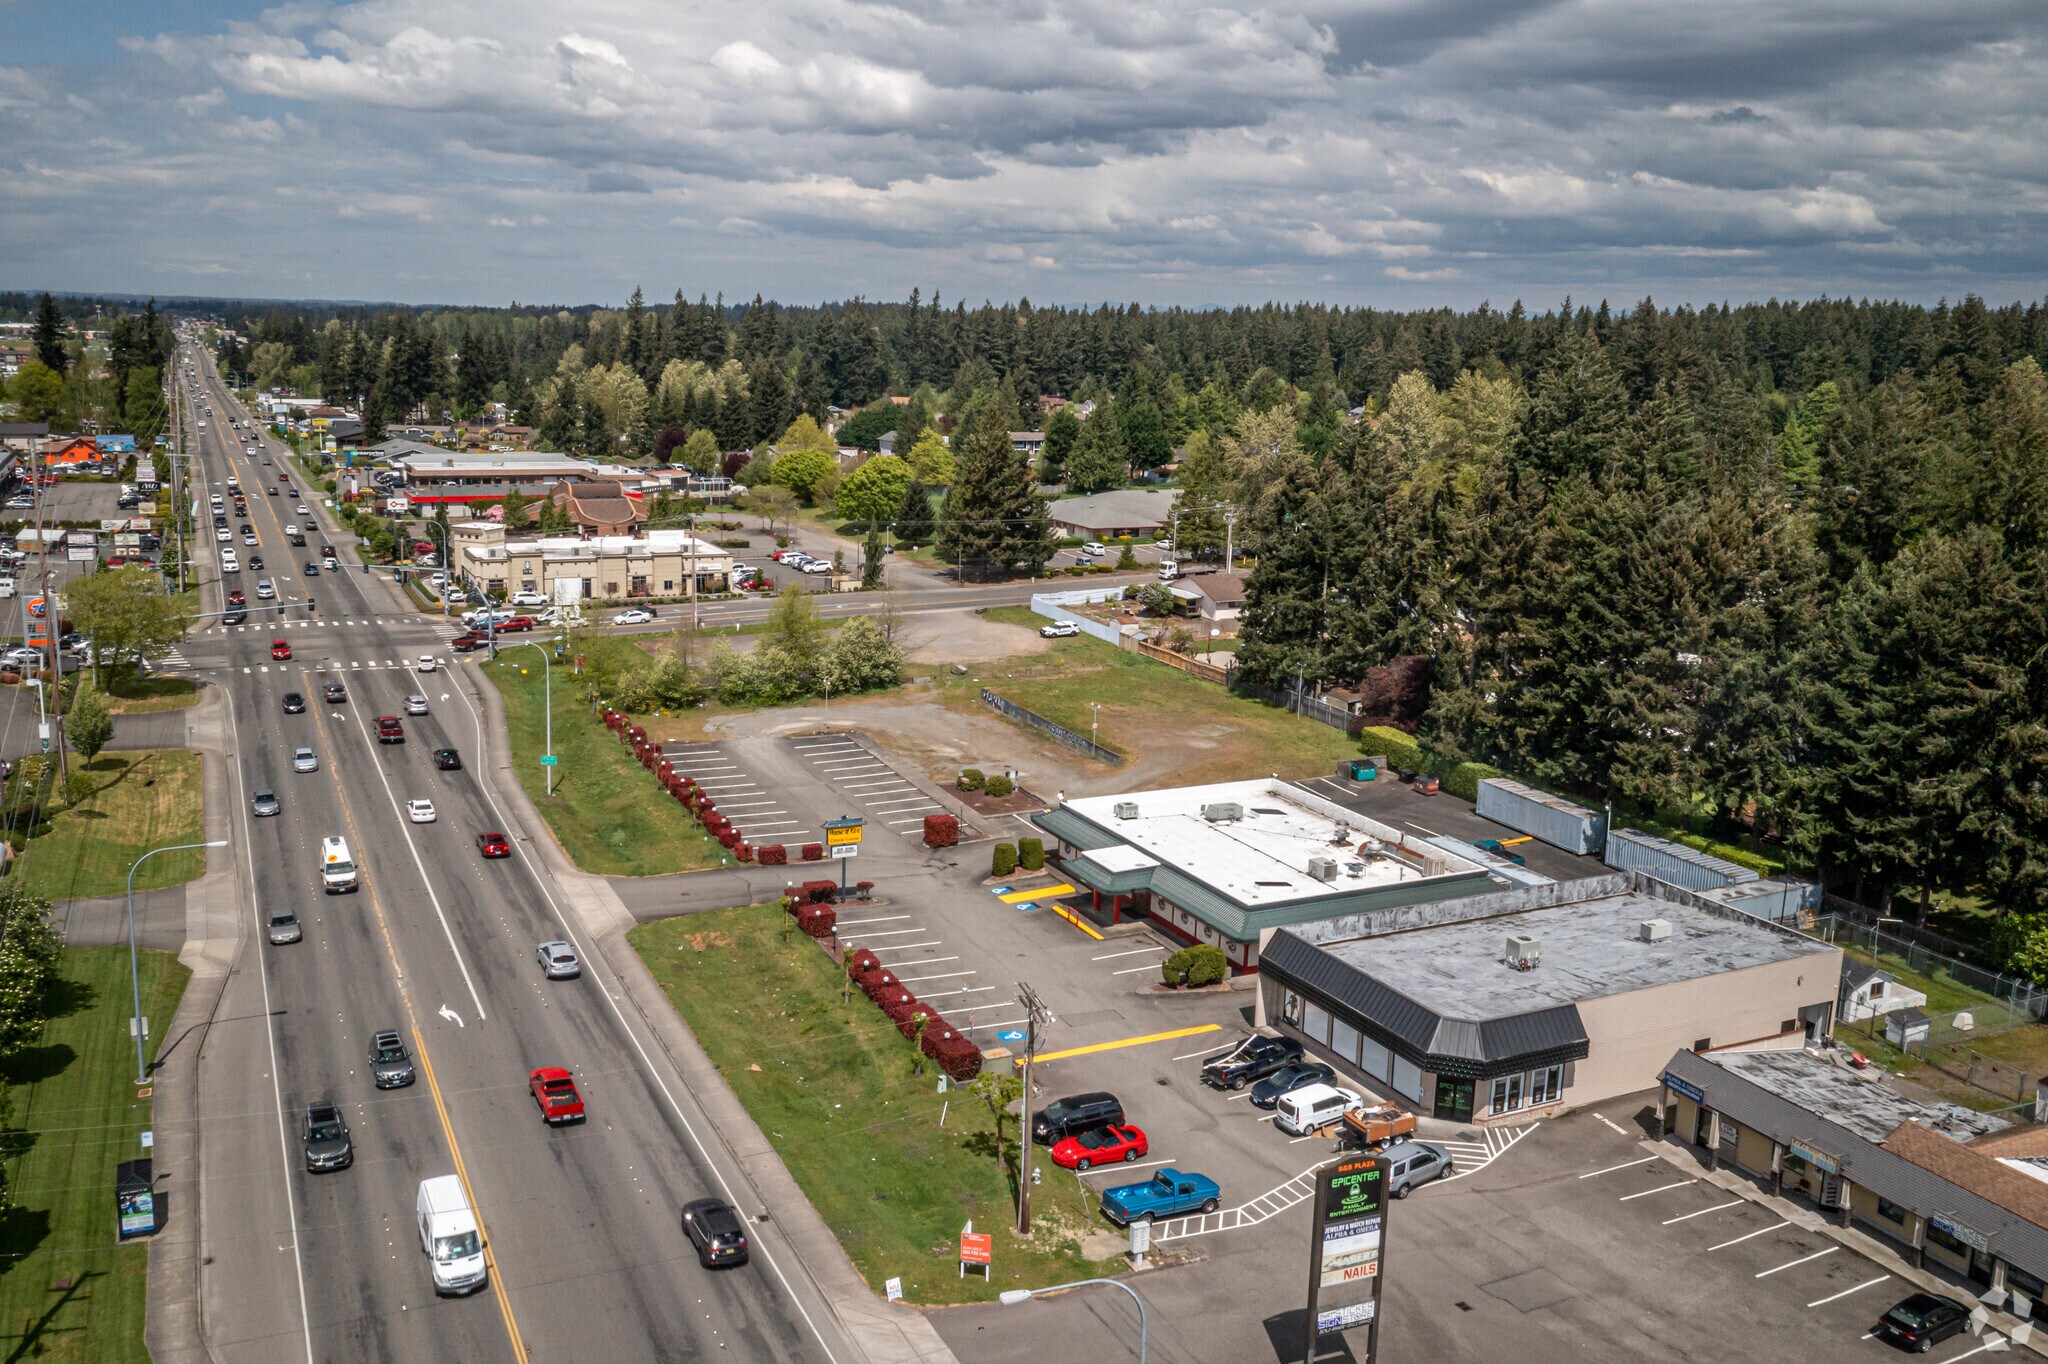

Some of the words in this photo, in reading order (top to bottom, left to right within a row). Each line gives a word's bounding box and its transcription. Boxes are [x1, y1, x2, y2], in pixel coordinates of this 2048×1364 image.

[31, 603, 45, 614] 76
[1354, 1160, 1375, 1169] PLAZA
[1331, 1171, 1380, 1188] EPICENTER
[1329, 1204, 1377, 1217] ENTERTAINMENT
[1343, 1202, 1365, 1210] FAMILY
[1325, 1224, 1345, 1234] JEWELRY
[1349, 1220, 1365, 1229] WATCH
[1365, 1217, 1381, 1226] REPAIR
[1325, 1230, 1348, 1240] ALPHA
[1355, 1224, 1379, 1234] OMEGA
[1344, 1263, 1376, 1280] NAILS
